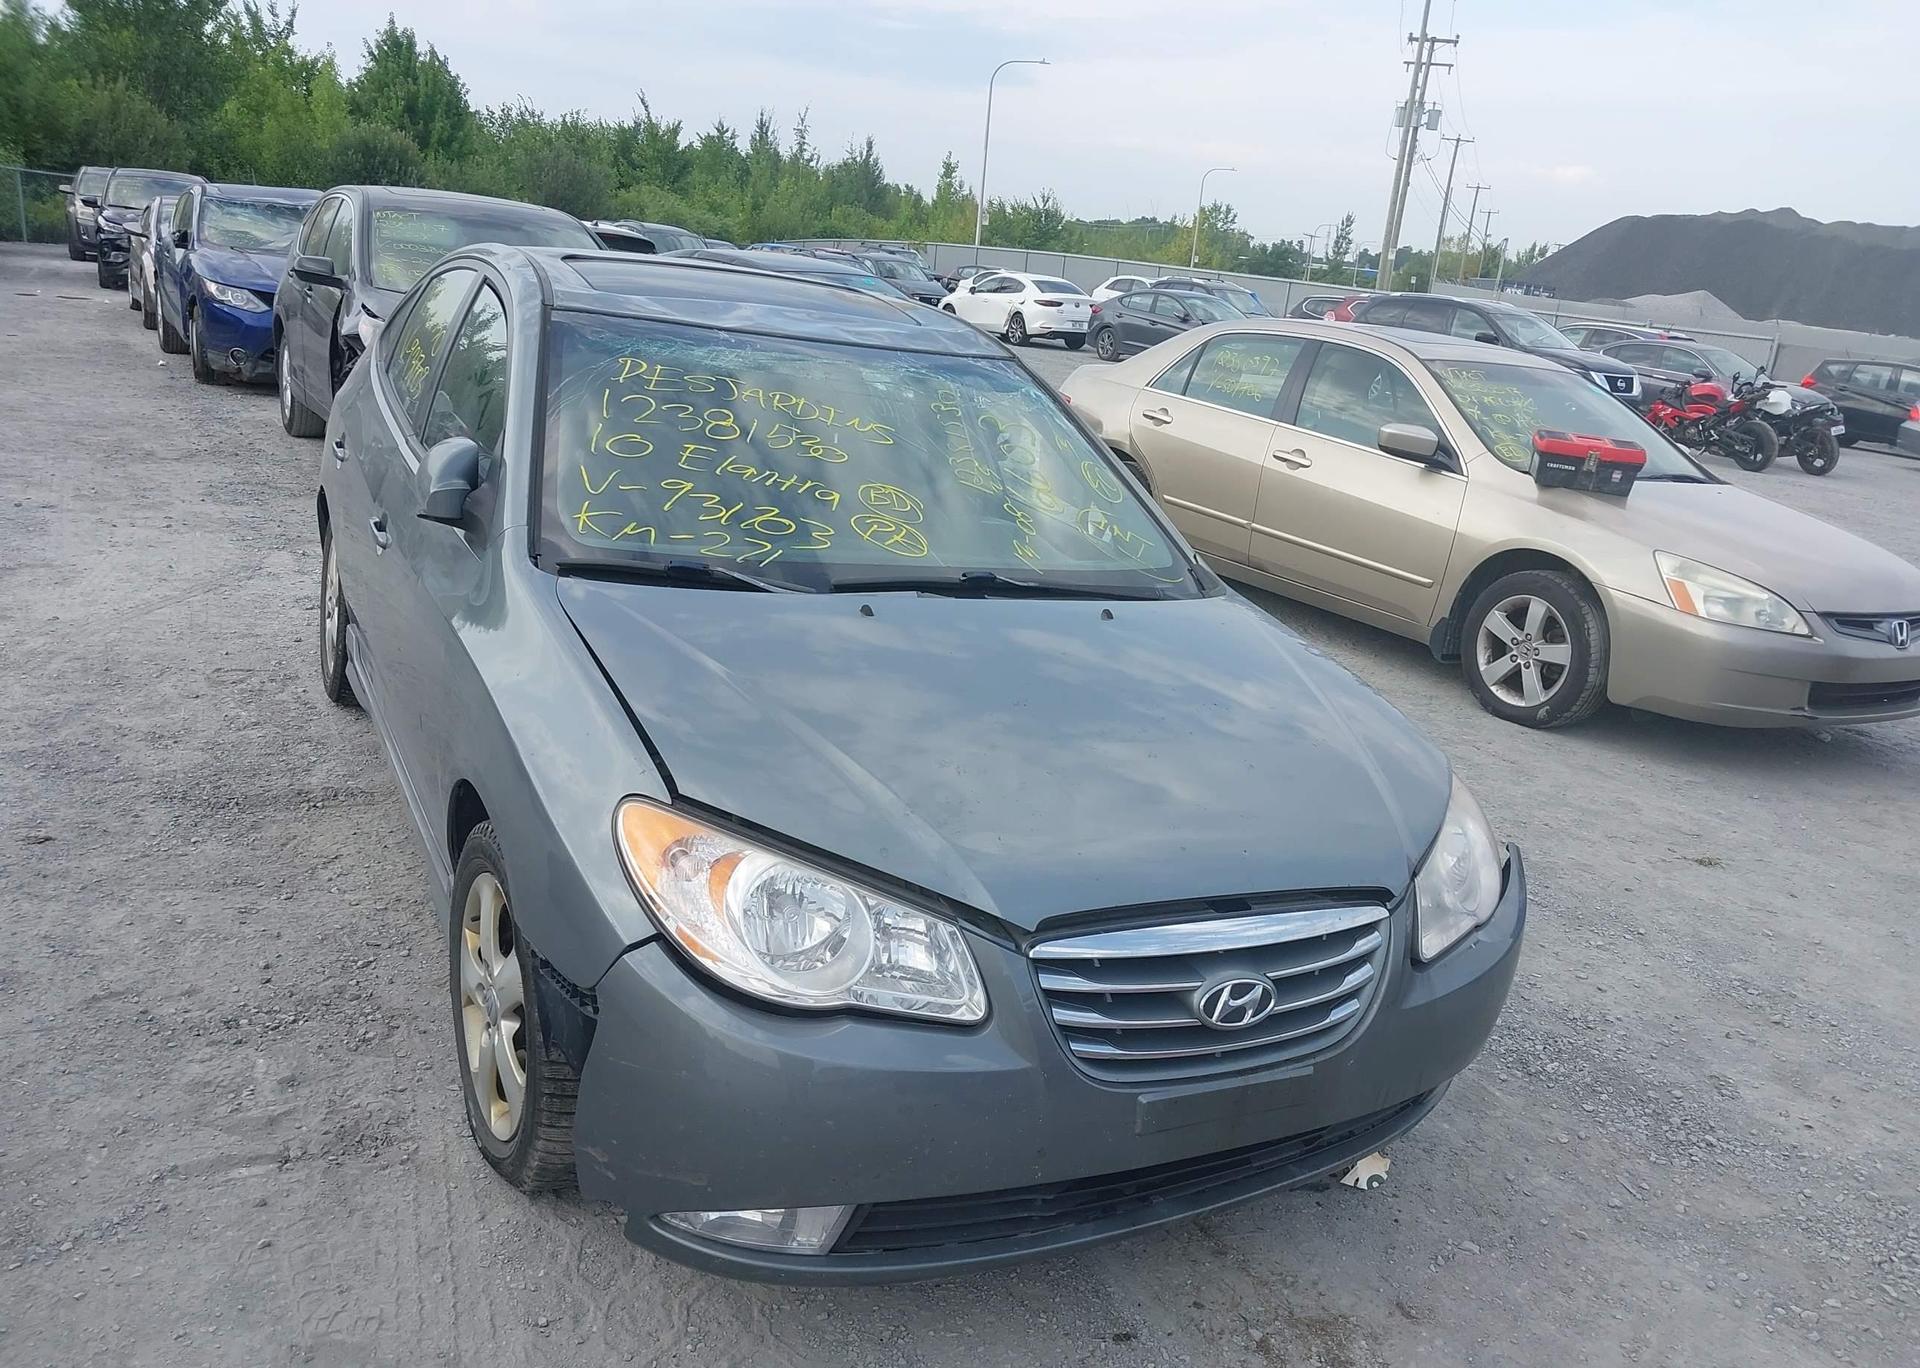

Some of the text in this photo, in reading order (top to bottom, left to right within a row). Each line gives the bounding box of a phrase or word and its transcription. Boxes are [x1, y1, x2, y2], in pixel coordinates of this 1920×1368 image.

[603, 389, 848, 463] 12381530
[611, 357, 895, 445] DESJARDINS
[592, 423, 840, 511] 10 Elantra
[1546, 462, 1576, 471] CRAFTSMAN
